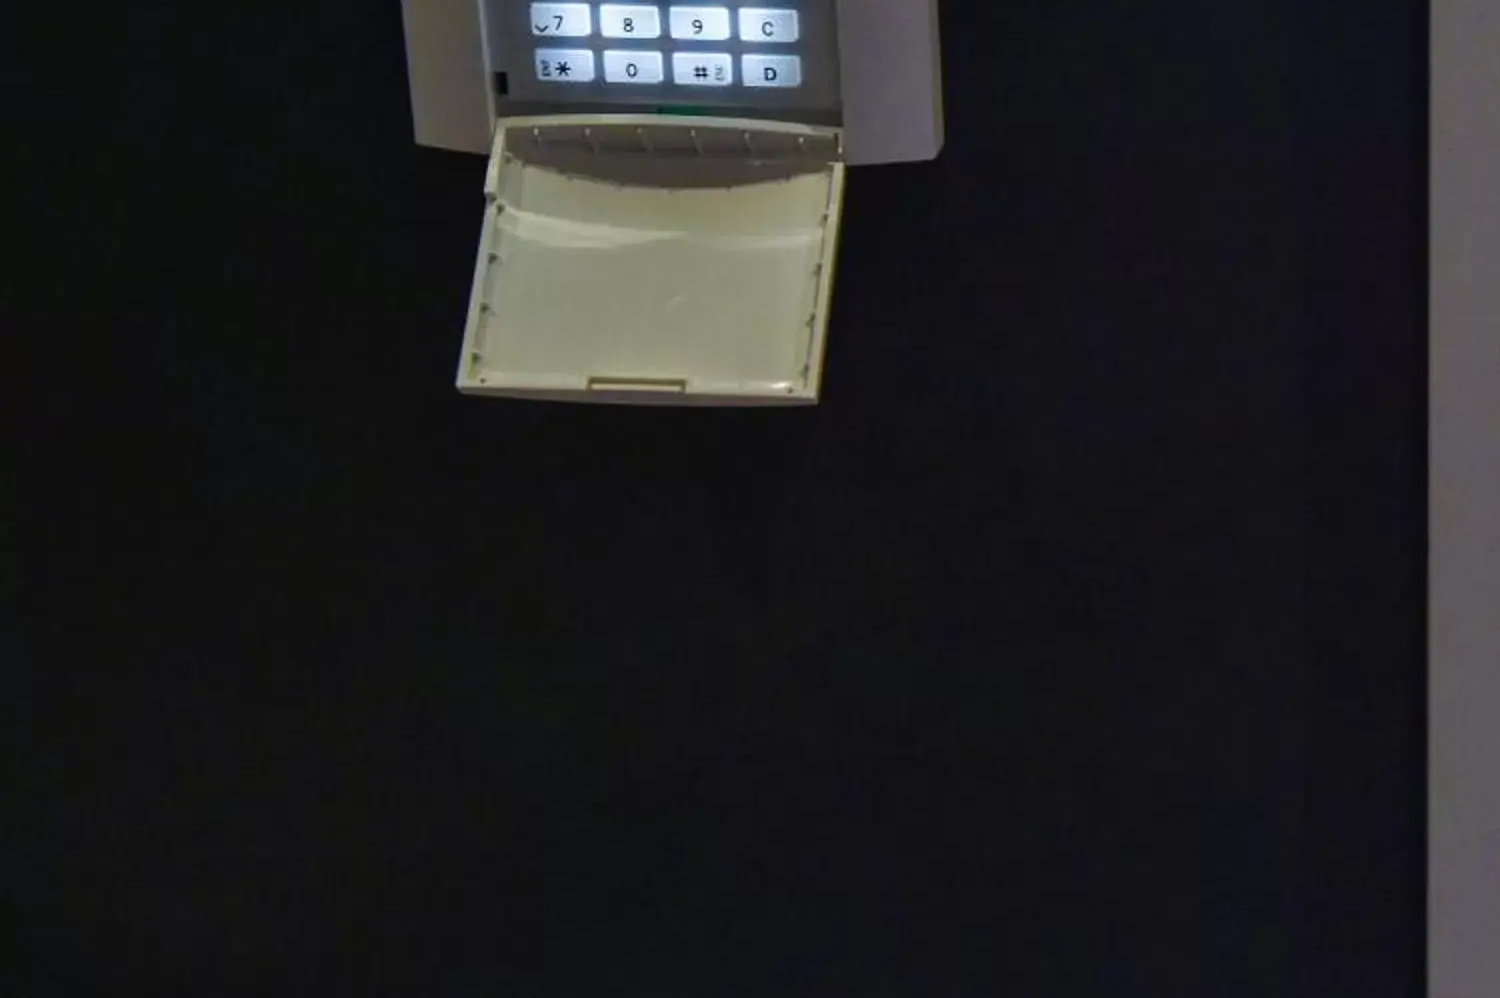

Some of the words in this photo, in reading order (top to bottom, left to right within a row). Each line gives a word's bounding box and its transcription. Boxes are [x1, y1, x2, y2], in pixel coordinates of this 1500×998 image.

[553, 15, 564, 32] 7
[623, 17, 634, 33] 8
[692, 19, 703, 35] 9
[762, 21, 774, 38] C
[764, 67, 777, 82] D
